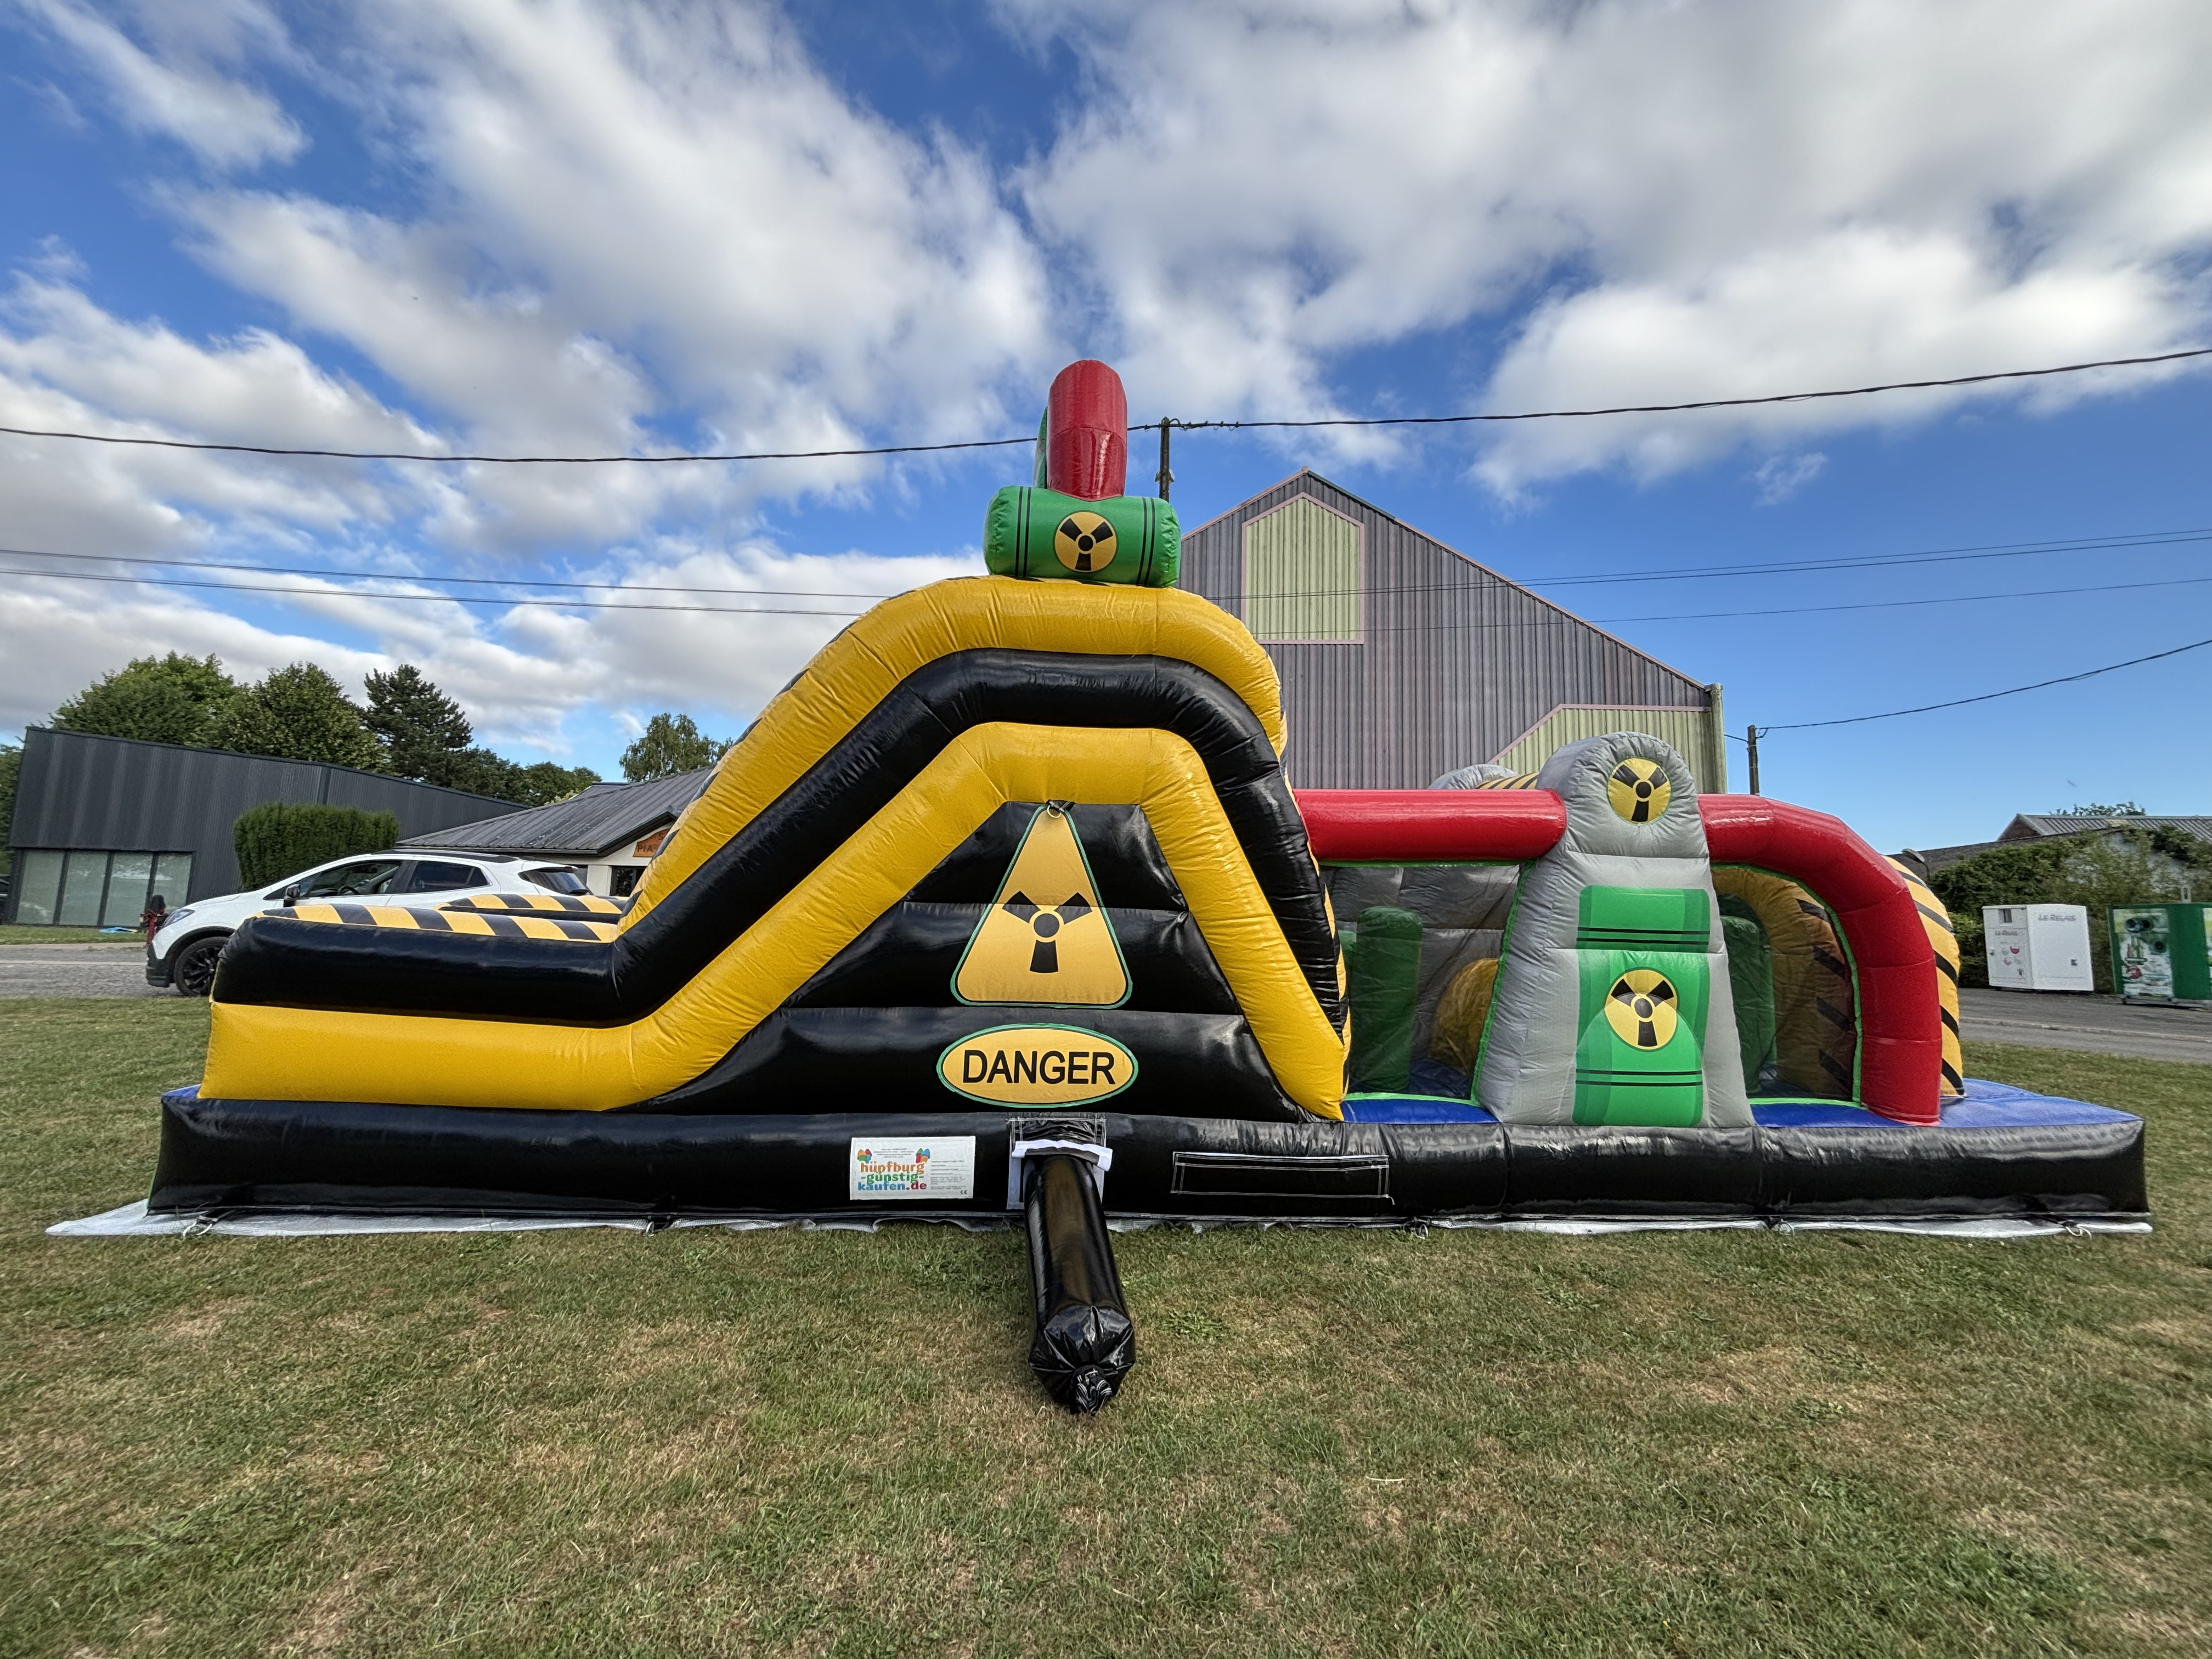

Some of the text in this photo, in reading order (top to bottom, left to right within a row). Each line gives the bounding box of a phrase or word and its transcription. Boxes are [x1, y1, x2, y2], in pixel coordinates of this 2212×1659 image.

[963, 1049, 1116, 1085] DANGER
[861, 1161, 924, 1175] hüpfburg
[858, 1180, 927, 1190] kaufen.de
